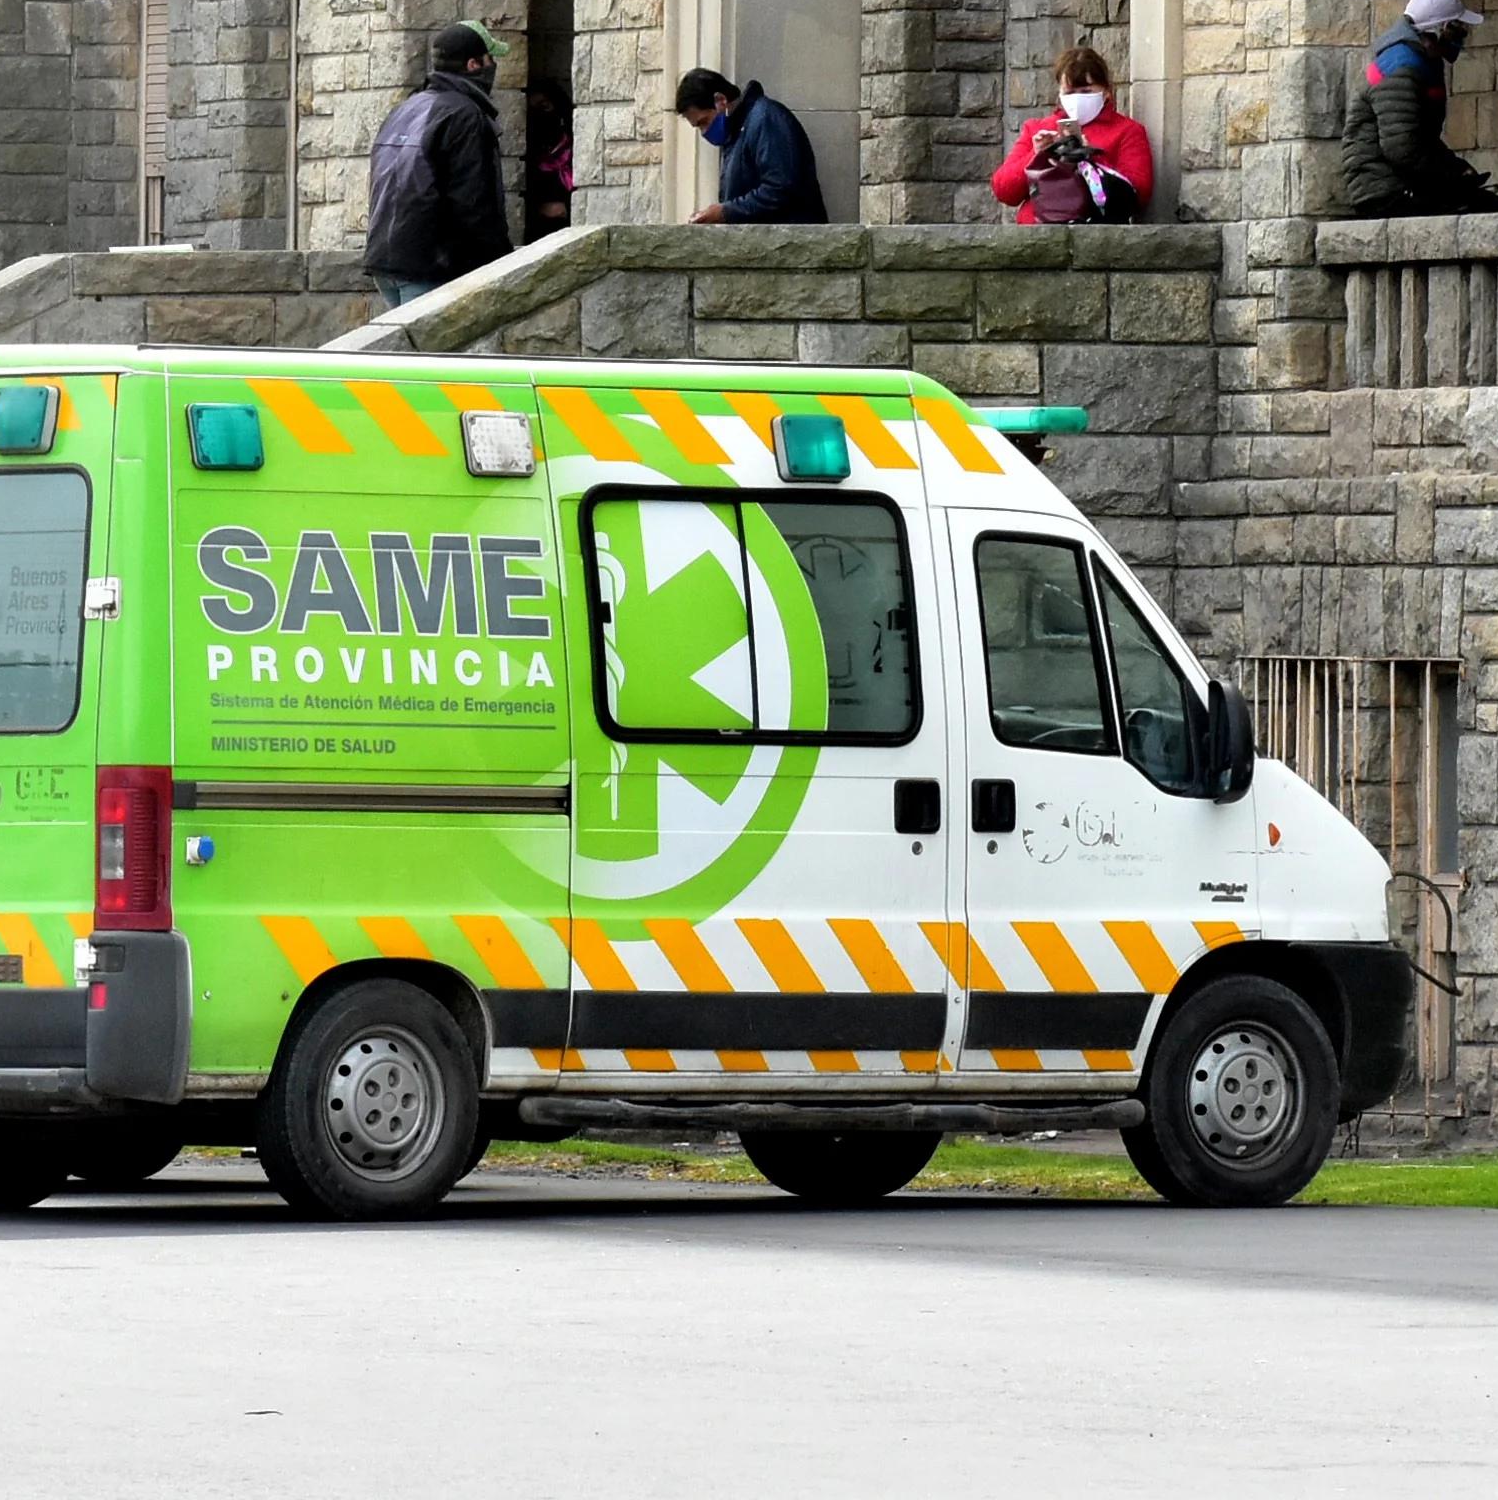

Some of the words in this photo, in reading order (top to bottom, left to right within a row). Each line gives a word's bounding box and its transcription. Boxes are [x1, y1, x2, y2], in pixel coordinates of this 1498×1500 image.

[10, 565, 68, 586] Buenos
[197, 525, 551, 639] SAME
[7, 589, 50, 611] Aires
[206, 644, 555, 688] PROVINCIA
[210, 692, 274, 709] Sistema
[279, 694, 299, 710] de
[304, 693, 374, 711] Atención
[378, 695, 435, 712] Médica
[440, 697, 460, 713] de
[464, 697, 556, 716] Emergencia
[211, 736, 309, 753] MINISTERIO
[314, 737, 337, 753] DE
[341, 737, 397, 754] SALUD
